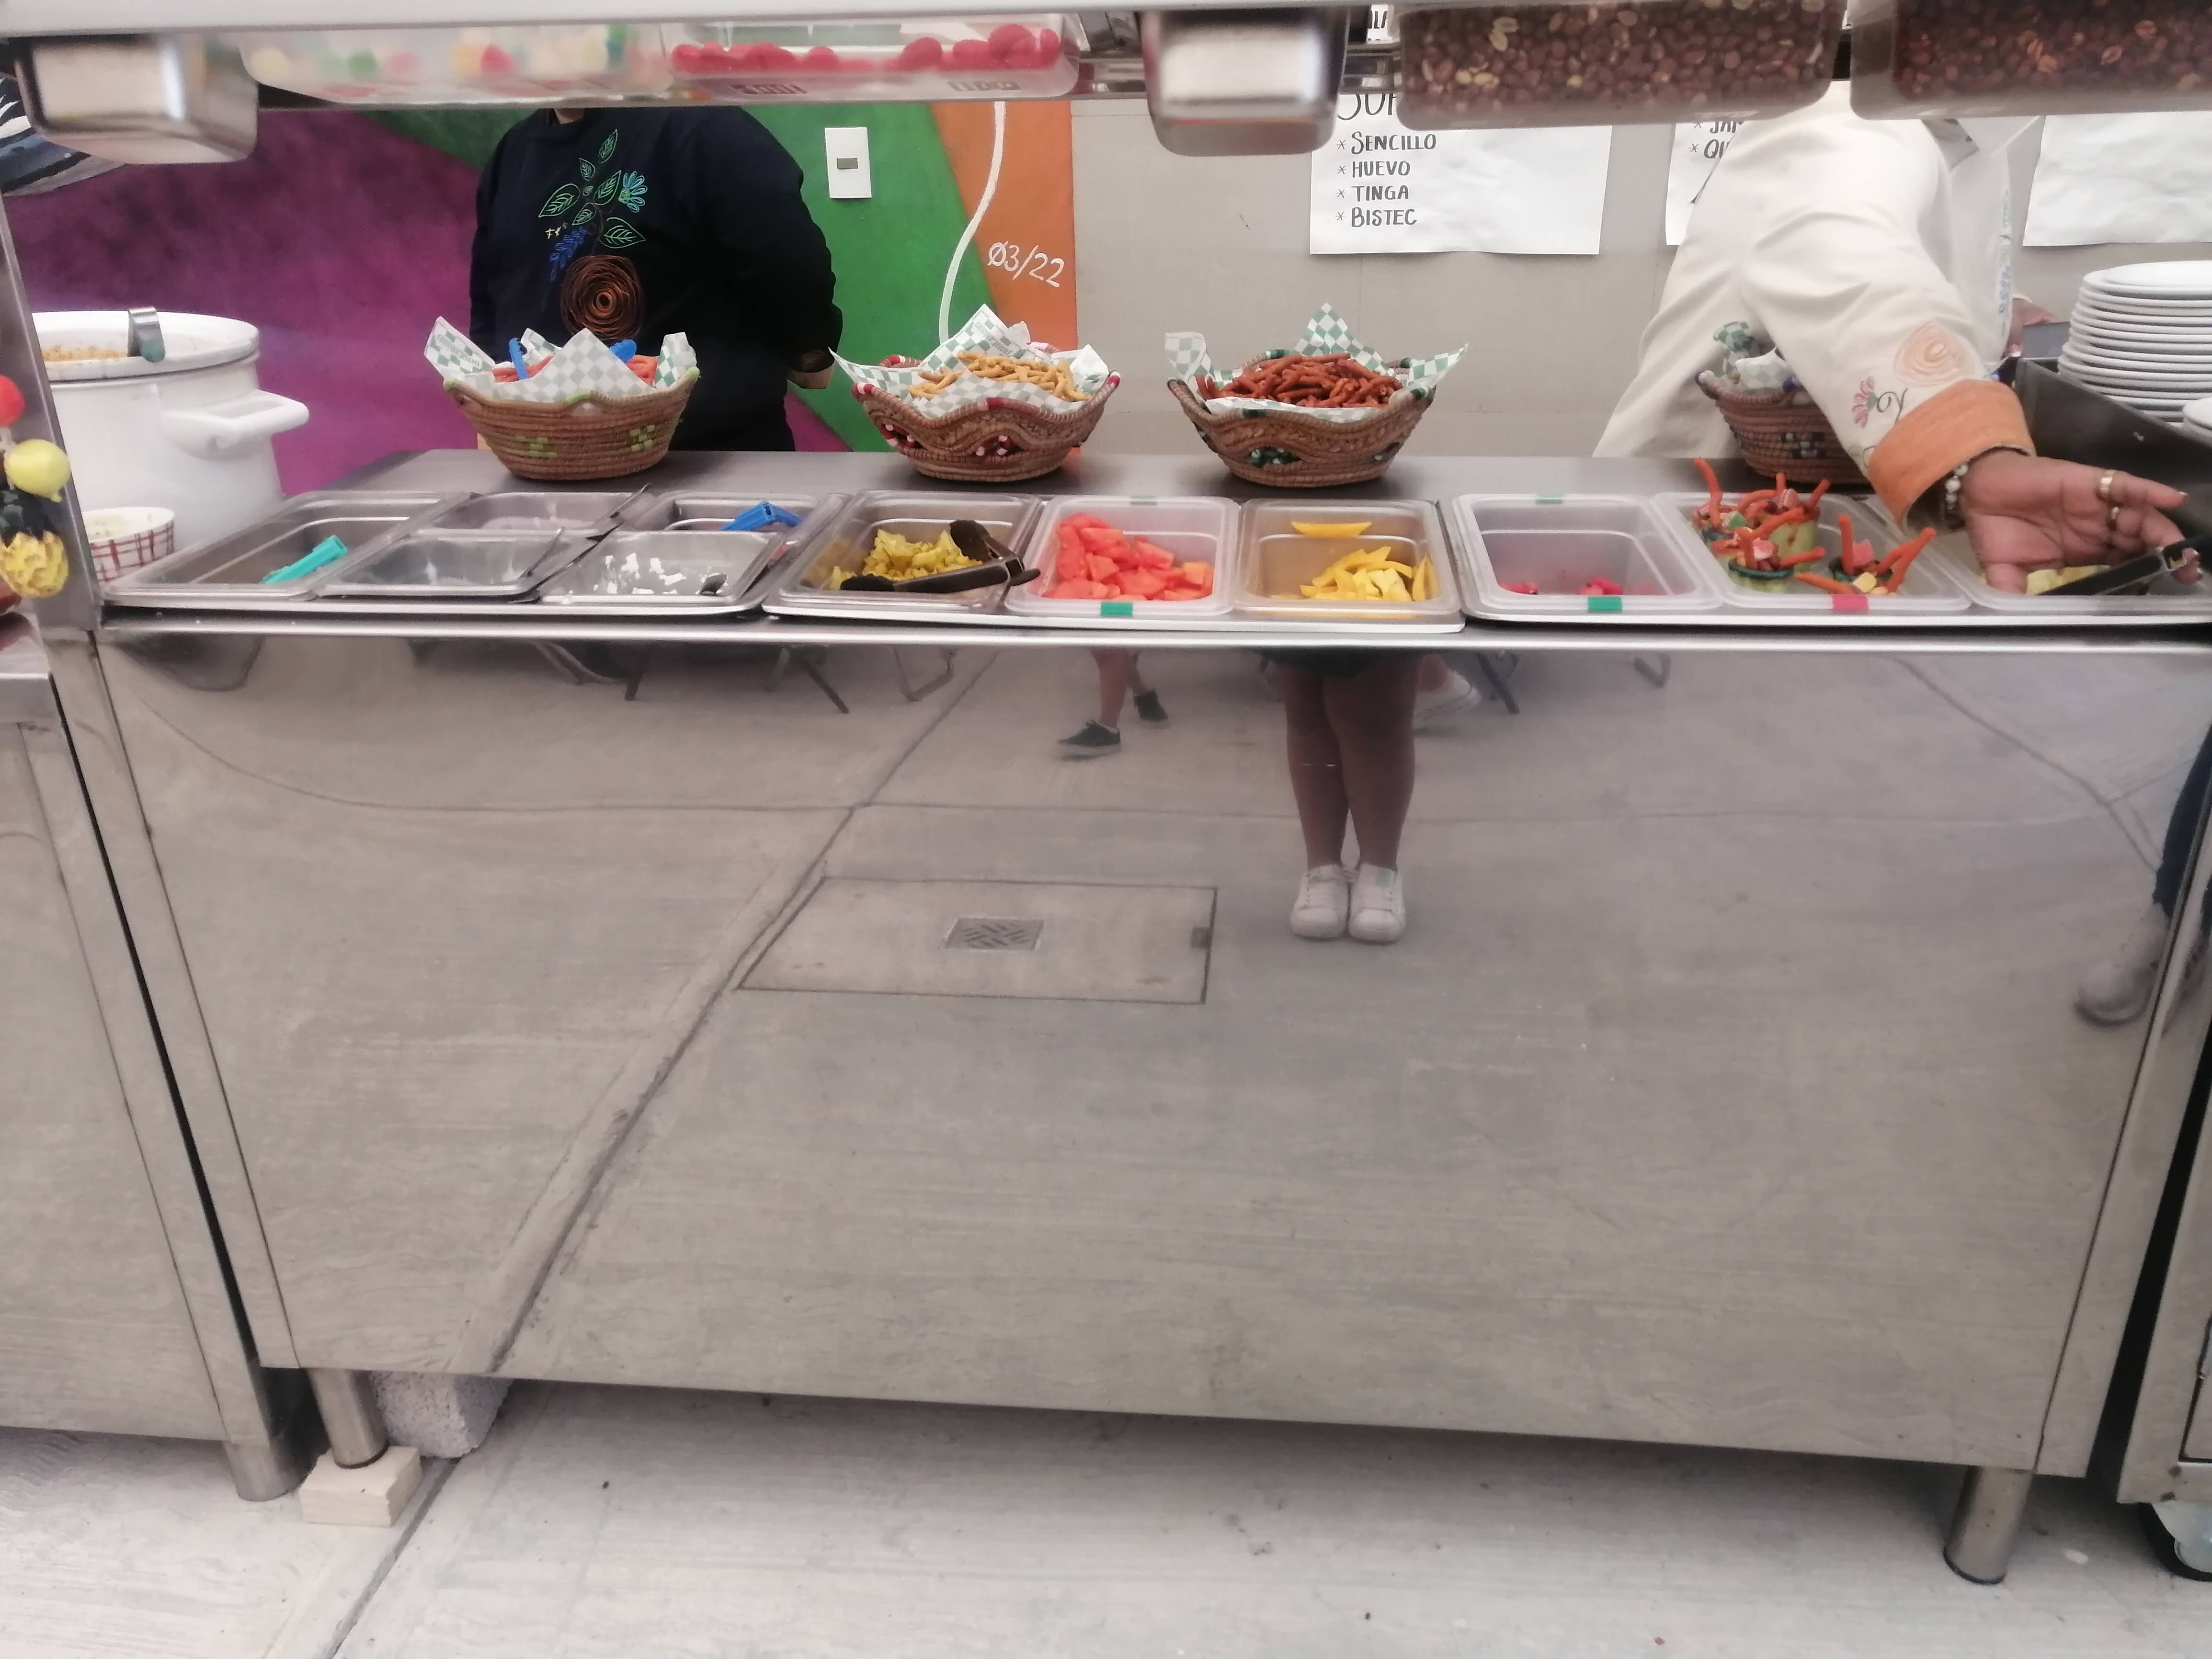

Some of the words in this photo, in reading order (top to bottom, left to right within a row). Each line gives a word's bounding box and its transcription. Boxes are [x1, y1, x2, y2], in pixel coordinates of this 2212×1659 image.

[1351, 131, 1437, 154] SENCILLO
[1352, 160, 1410, 178] HUEVO
[1351, 185, 1409, 202] TINGA
[1351, 207, 1417, 227] BISTEC
